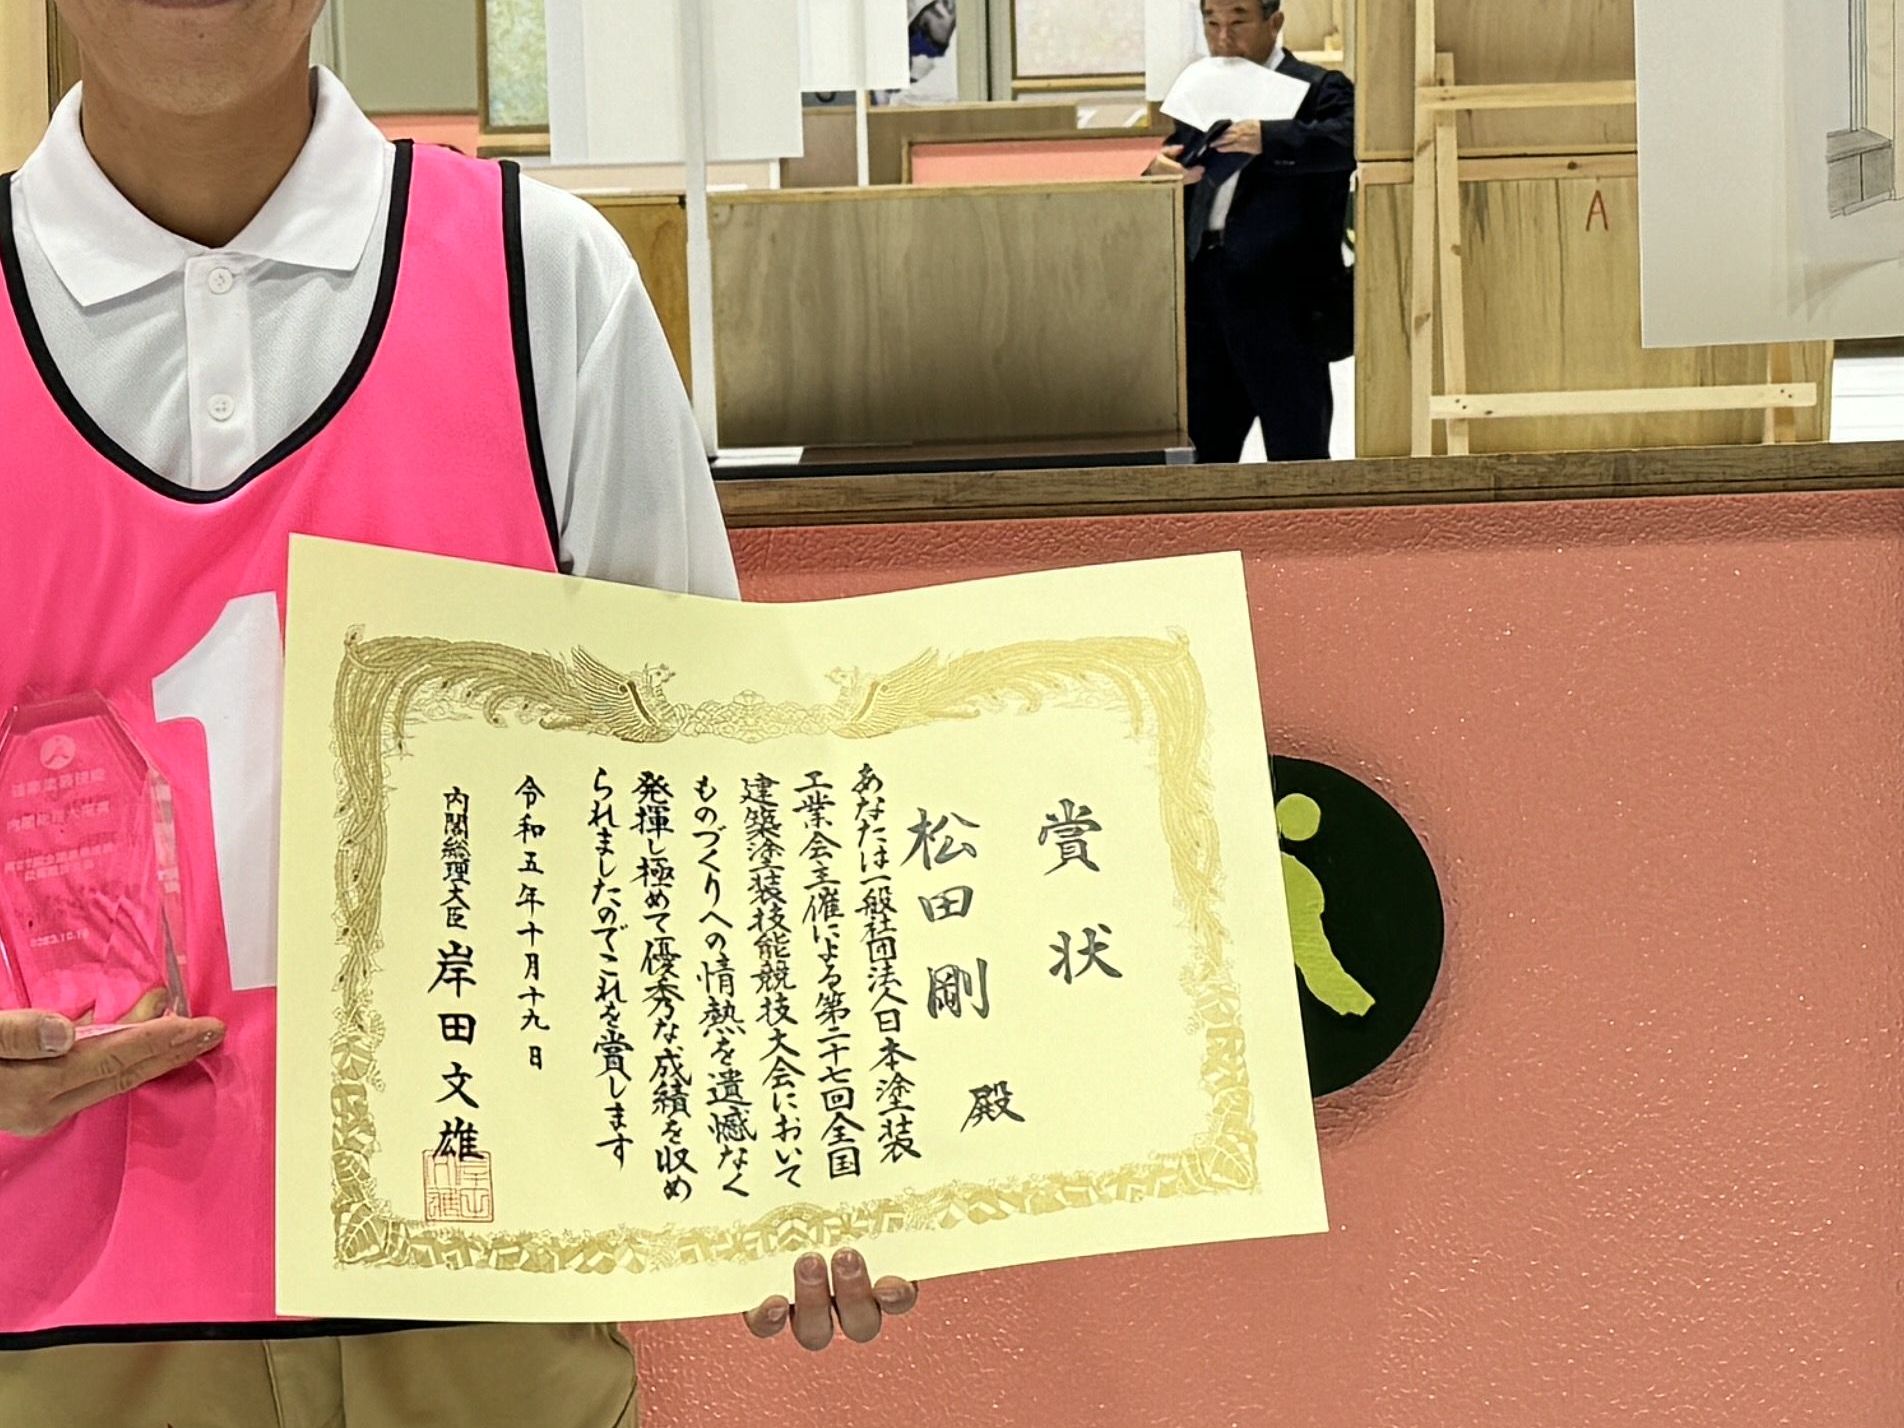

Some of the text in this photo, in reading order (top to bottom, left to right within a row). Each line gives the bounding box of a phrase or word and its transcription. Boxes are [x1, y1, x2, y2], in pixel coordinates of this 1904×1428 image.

[1585, 189, 1608, 232] A
[152, 591, 286, 990] 1
[440, 786, 471, 931] 内閣総理大臣
[512, 774, 551, 1071] 令和五年十月十九日
[587, 766, 635, 1171] られましたのでこれを賞します
[629, 770, 698, 1203] 発揮し極めて優秀な成績を収め
[691, 775, 757, 1198] ものづくりへの情熱を遺憾なく
[739, 773, 806, 1188] 建築塗装技能競技大会において
[793, 770, 865, 1180] 工業会主催による第二十七回全国
[850, 762, 922, 1164] あなたは一般社団法人日本塗装
[900, 807, 1026, 1133] 松田剛 殿
[1038, 798, 1124, 985] 賞状
[427, 940, 486, 1163] 岸田文雄
